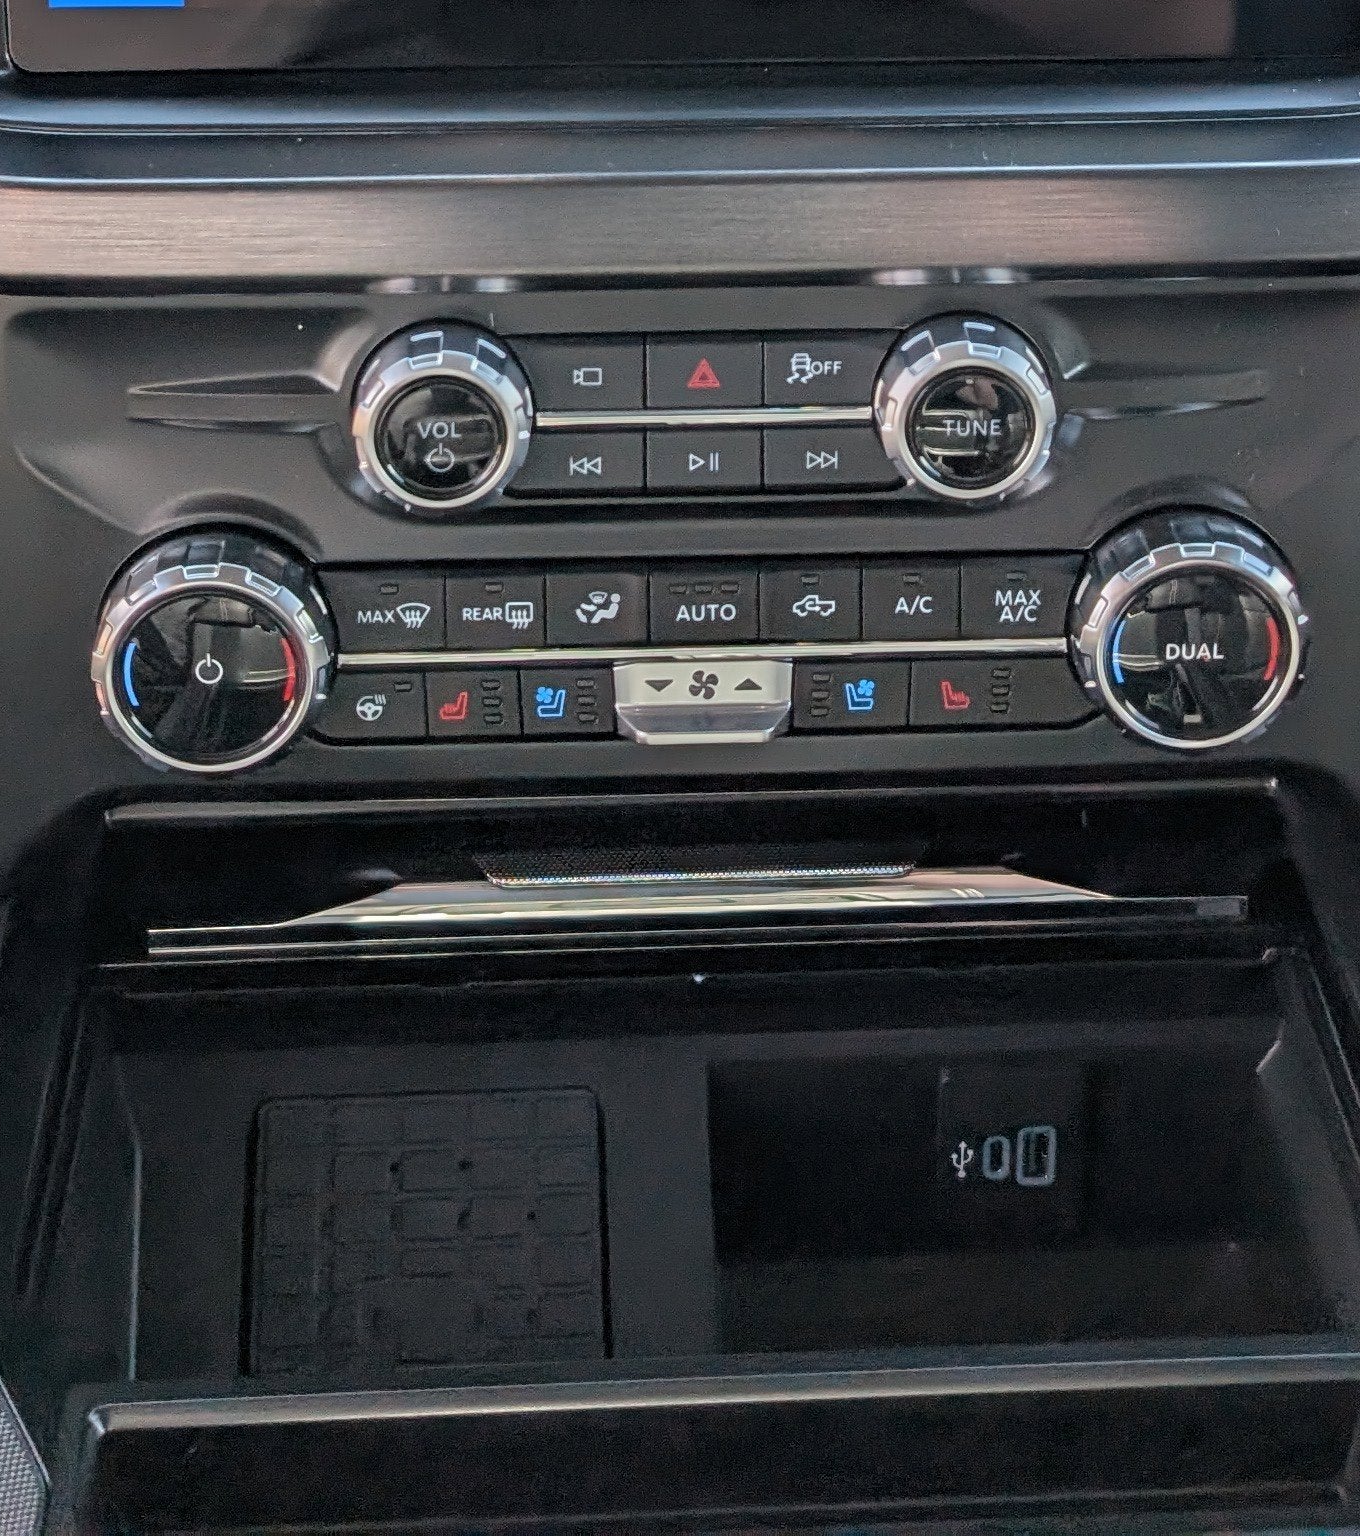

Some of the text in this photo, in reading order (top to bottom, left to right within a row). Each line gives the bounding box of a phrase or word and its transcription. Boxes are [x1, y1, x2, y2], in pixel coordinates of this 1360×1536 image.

[810, 360, 842, 376] OFF
[417, 420, 462, 439] VOL
[941, 419, 1002, 436] TUNE
[895, 596, 932, 614] A/C
[995, 589, 1040, 606] MAX
[358, 610, 394, 622] MAX
[463, 607, 502, 620] REAR
[676, 604, 736, 621] AUTO
[1000, 605, 1036, 622] A/C
[1166, 643, 1223, 660] DUAL
